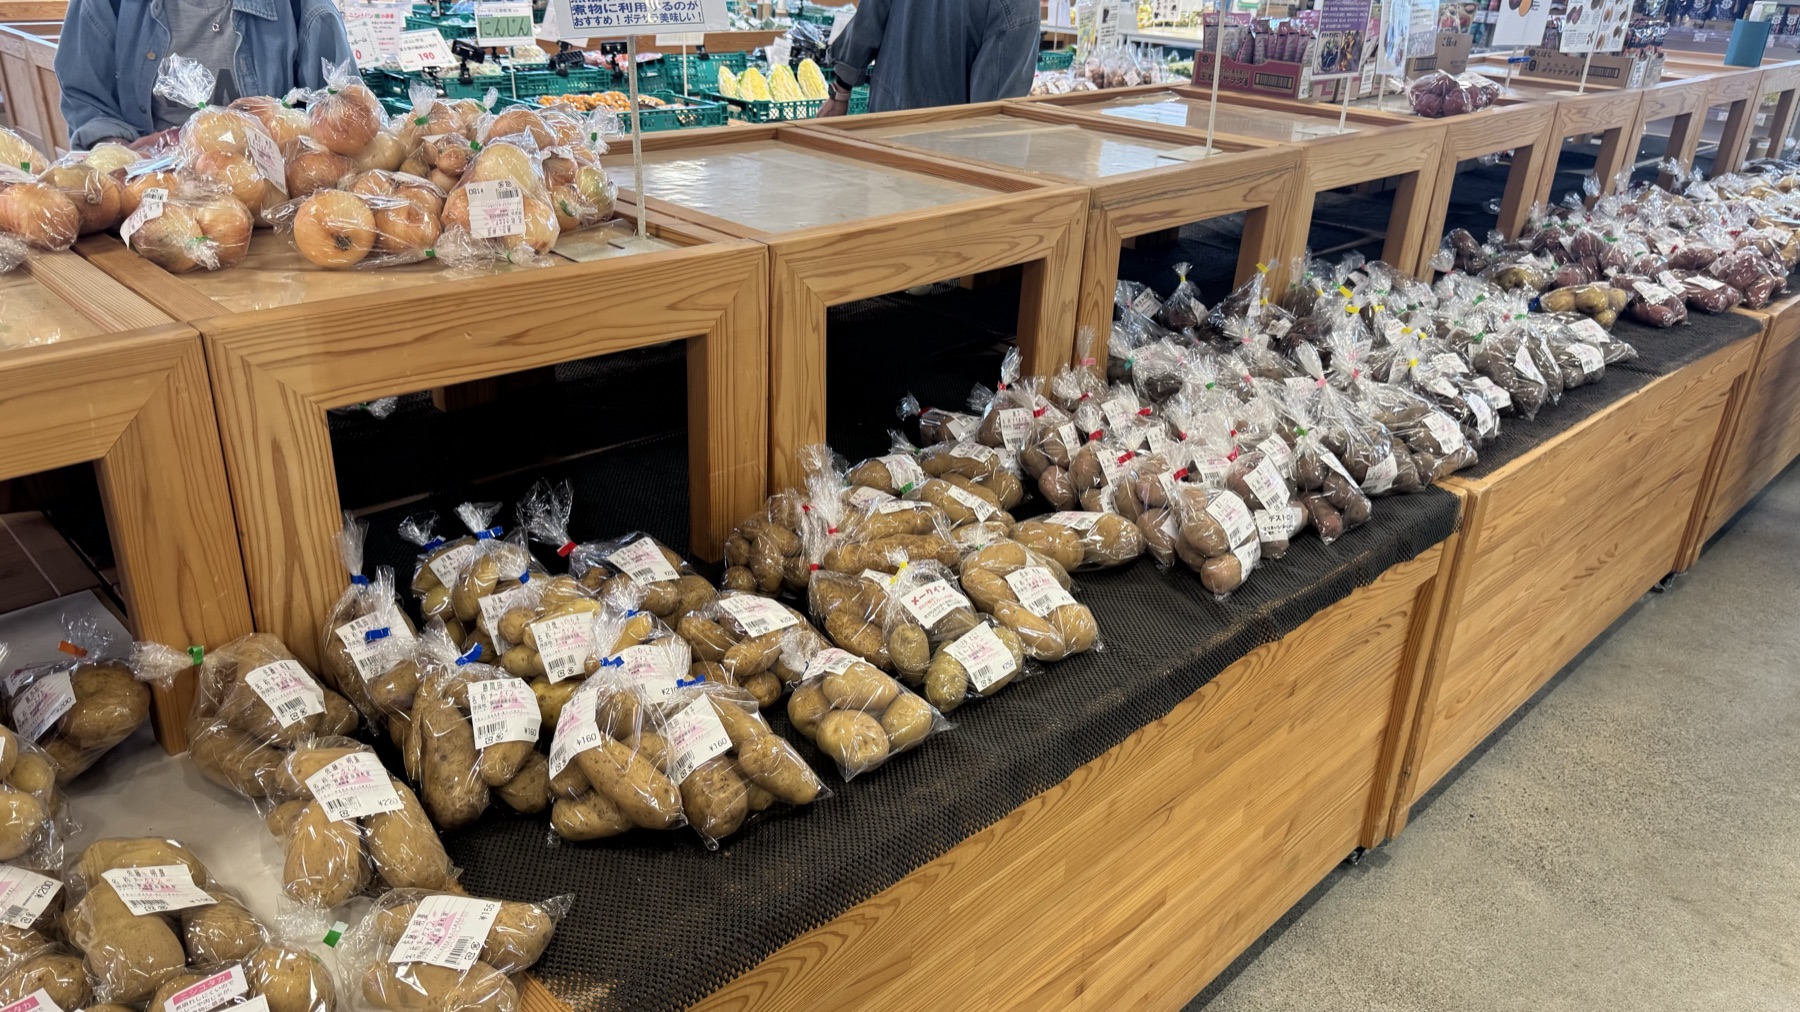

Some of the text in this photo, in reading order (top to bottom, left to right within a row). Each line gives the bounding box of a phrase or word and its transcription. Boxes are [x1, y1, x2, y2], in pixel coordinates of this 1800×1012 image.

[479, 17, 529, 38] にんじん
[418, 51, 435, 61] 190
[524, 727, 537, 736] ¥160
[576, 732, 597, 746] ¥160
[709, 737, 728, 752] ¥160
[34, 879, 55, 899] ¥200
[479, 902, 496, 921] ¥155
[182, 989, 233, 1012] レーや肉じゃが、
